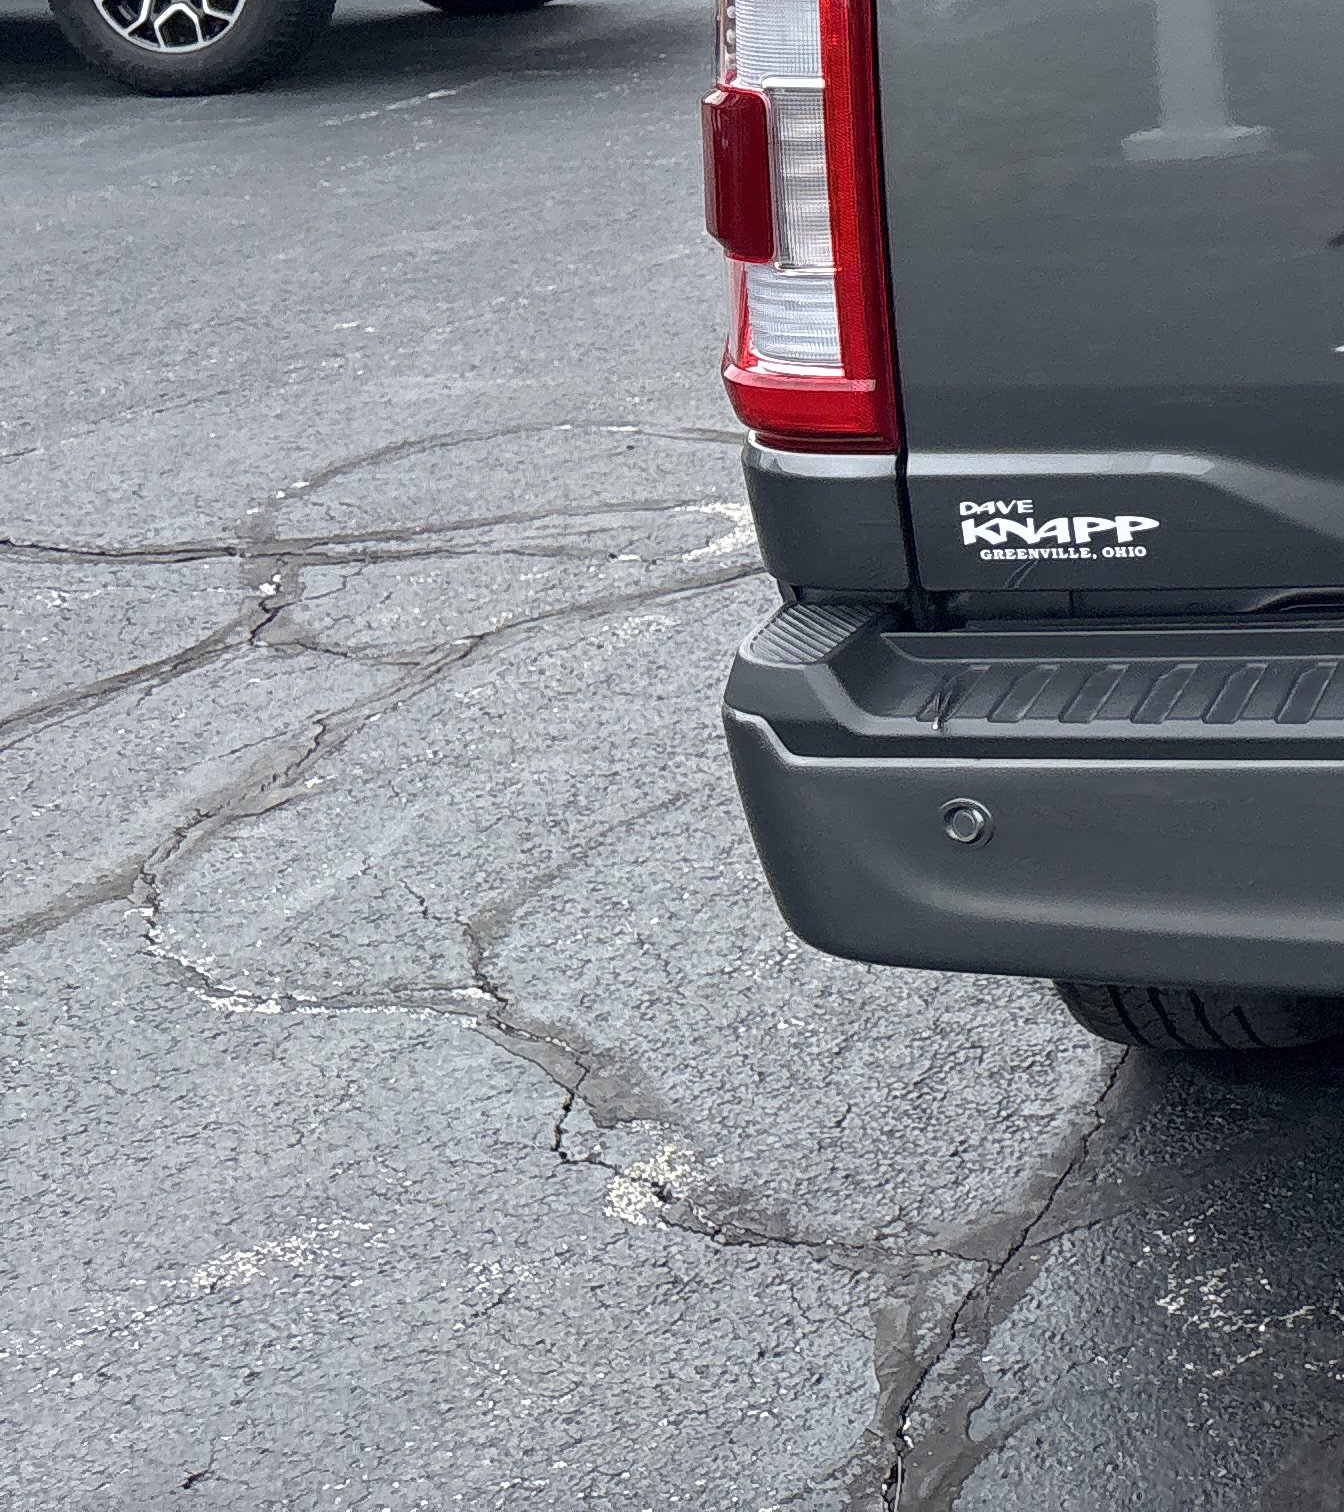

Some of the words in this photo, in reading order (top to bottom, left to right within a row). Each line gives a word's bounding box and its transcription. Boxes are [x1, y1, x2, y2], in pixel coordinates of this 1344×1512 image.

[959, 500, 1034, 516] DAVE
[961, 516, 1160, 545] KNAPP
[980, 547, 1098, 561] GREENVILLE,
[1102, 546, 1147, 558] OHIO
